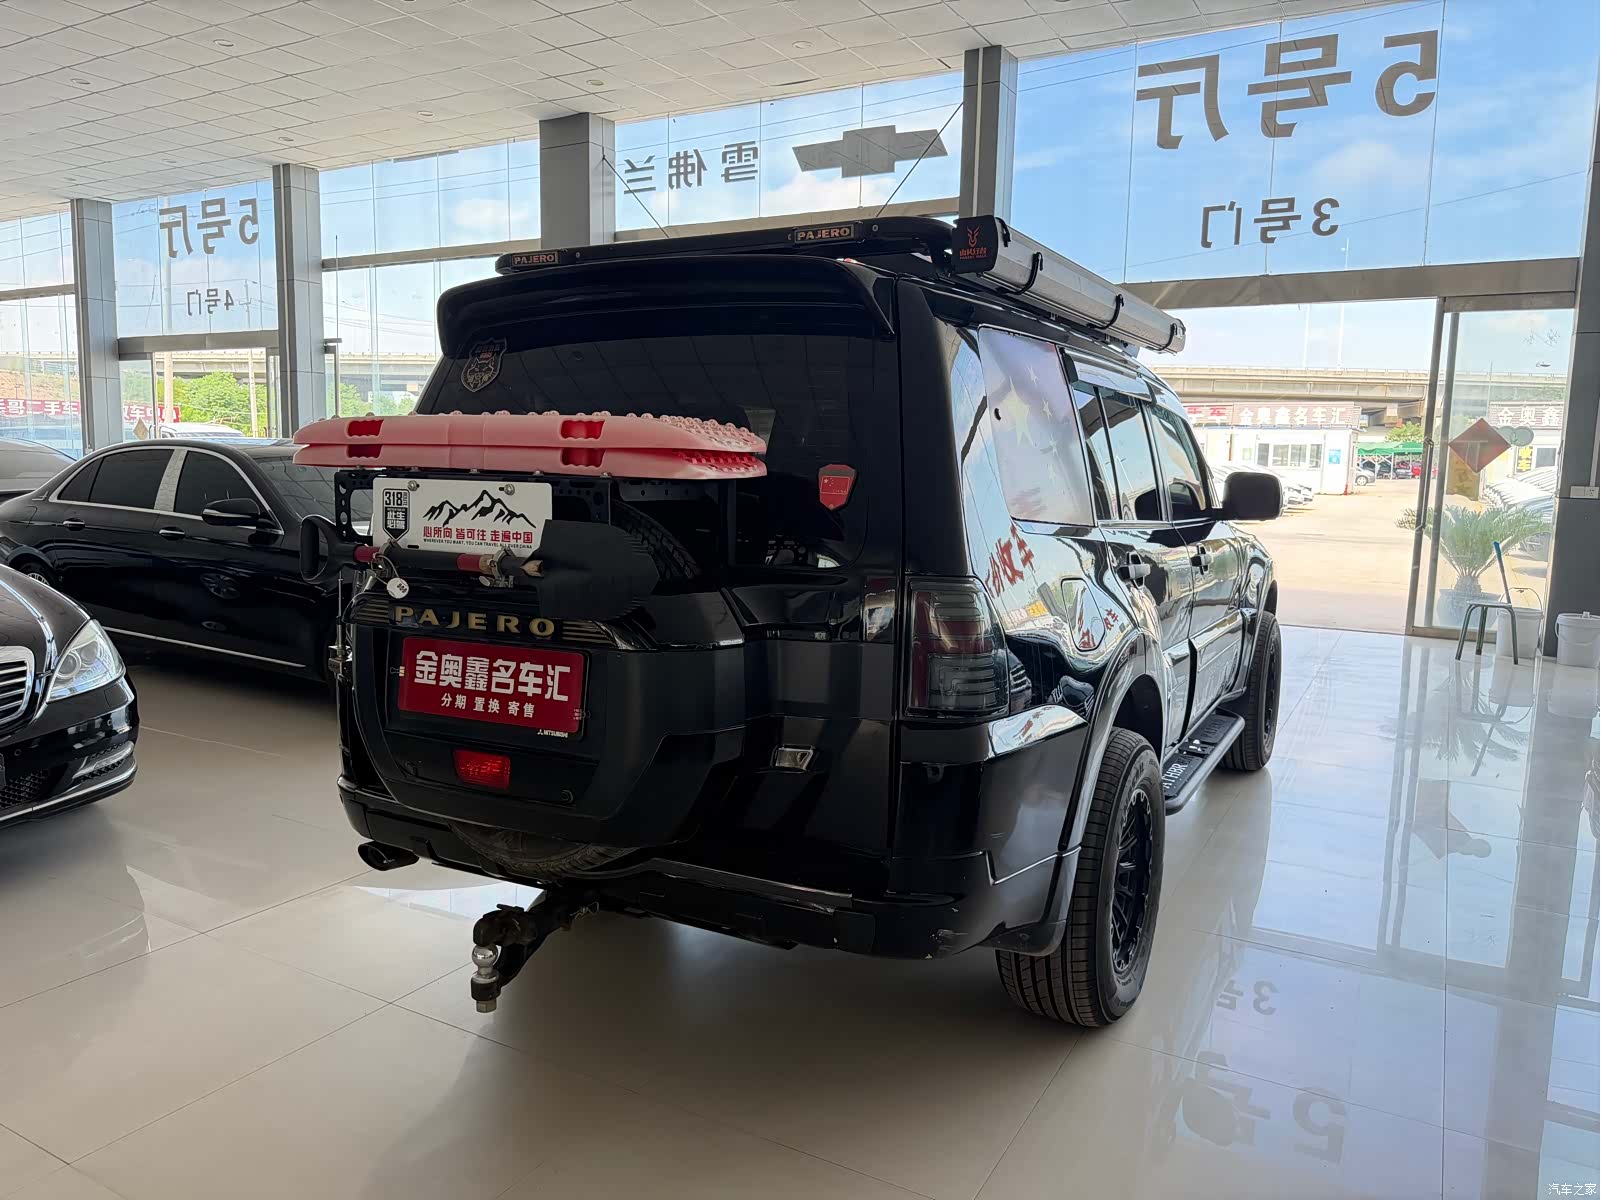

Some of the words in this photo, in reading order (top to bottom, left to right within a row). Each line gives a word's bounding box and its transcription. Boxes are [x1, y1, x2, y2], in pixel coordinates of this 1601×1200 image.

[798, 227, 850, 240] PAJERO
[514, 254, 555, 265] PAJERO
[1239, 406, 1346, 425] 金奥鑫名车汇
[1497, 404, 1562, 427] 金奥鑫
[384, 491, 403, 506] 318
[386, 510, 405, 520] 此生
[423, 526, 453, 539] 心所向
[455, 528, 487, 541] 皆可往
[490, 530, 533, 544] 走遍中国
[393, 605, 555, 637] PAJERO
[413, 650, 571, 702] 金奥鑫名车汇
[441, 692, 467, 710] 分期
[472, 696, 500, 714] 置换
[507, 700, 535, 718] 寄售
